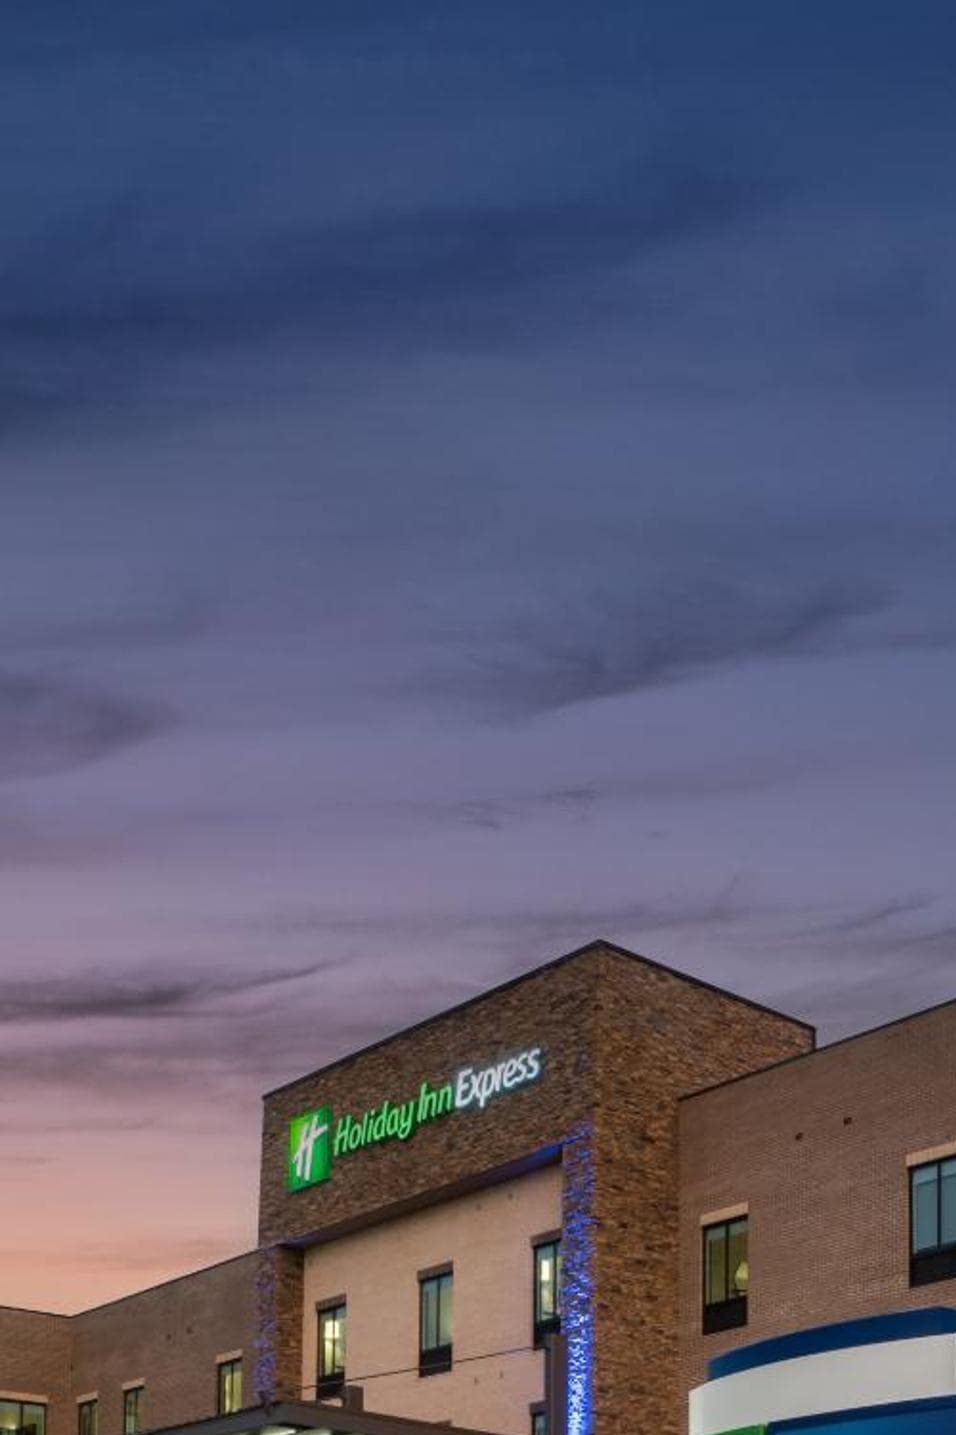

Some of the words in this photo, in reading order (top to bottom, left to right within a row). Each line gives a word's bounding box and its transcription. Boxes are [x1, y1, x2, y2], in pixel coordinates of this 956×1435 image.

[335, 1101, 414, 1156] Holiday
[417, 1082, 453, 1123] Inn
[455, 1047, 542, 1109] Express
